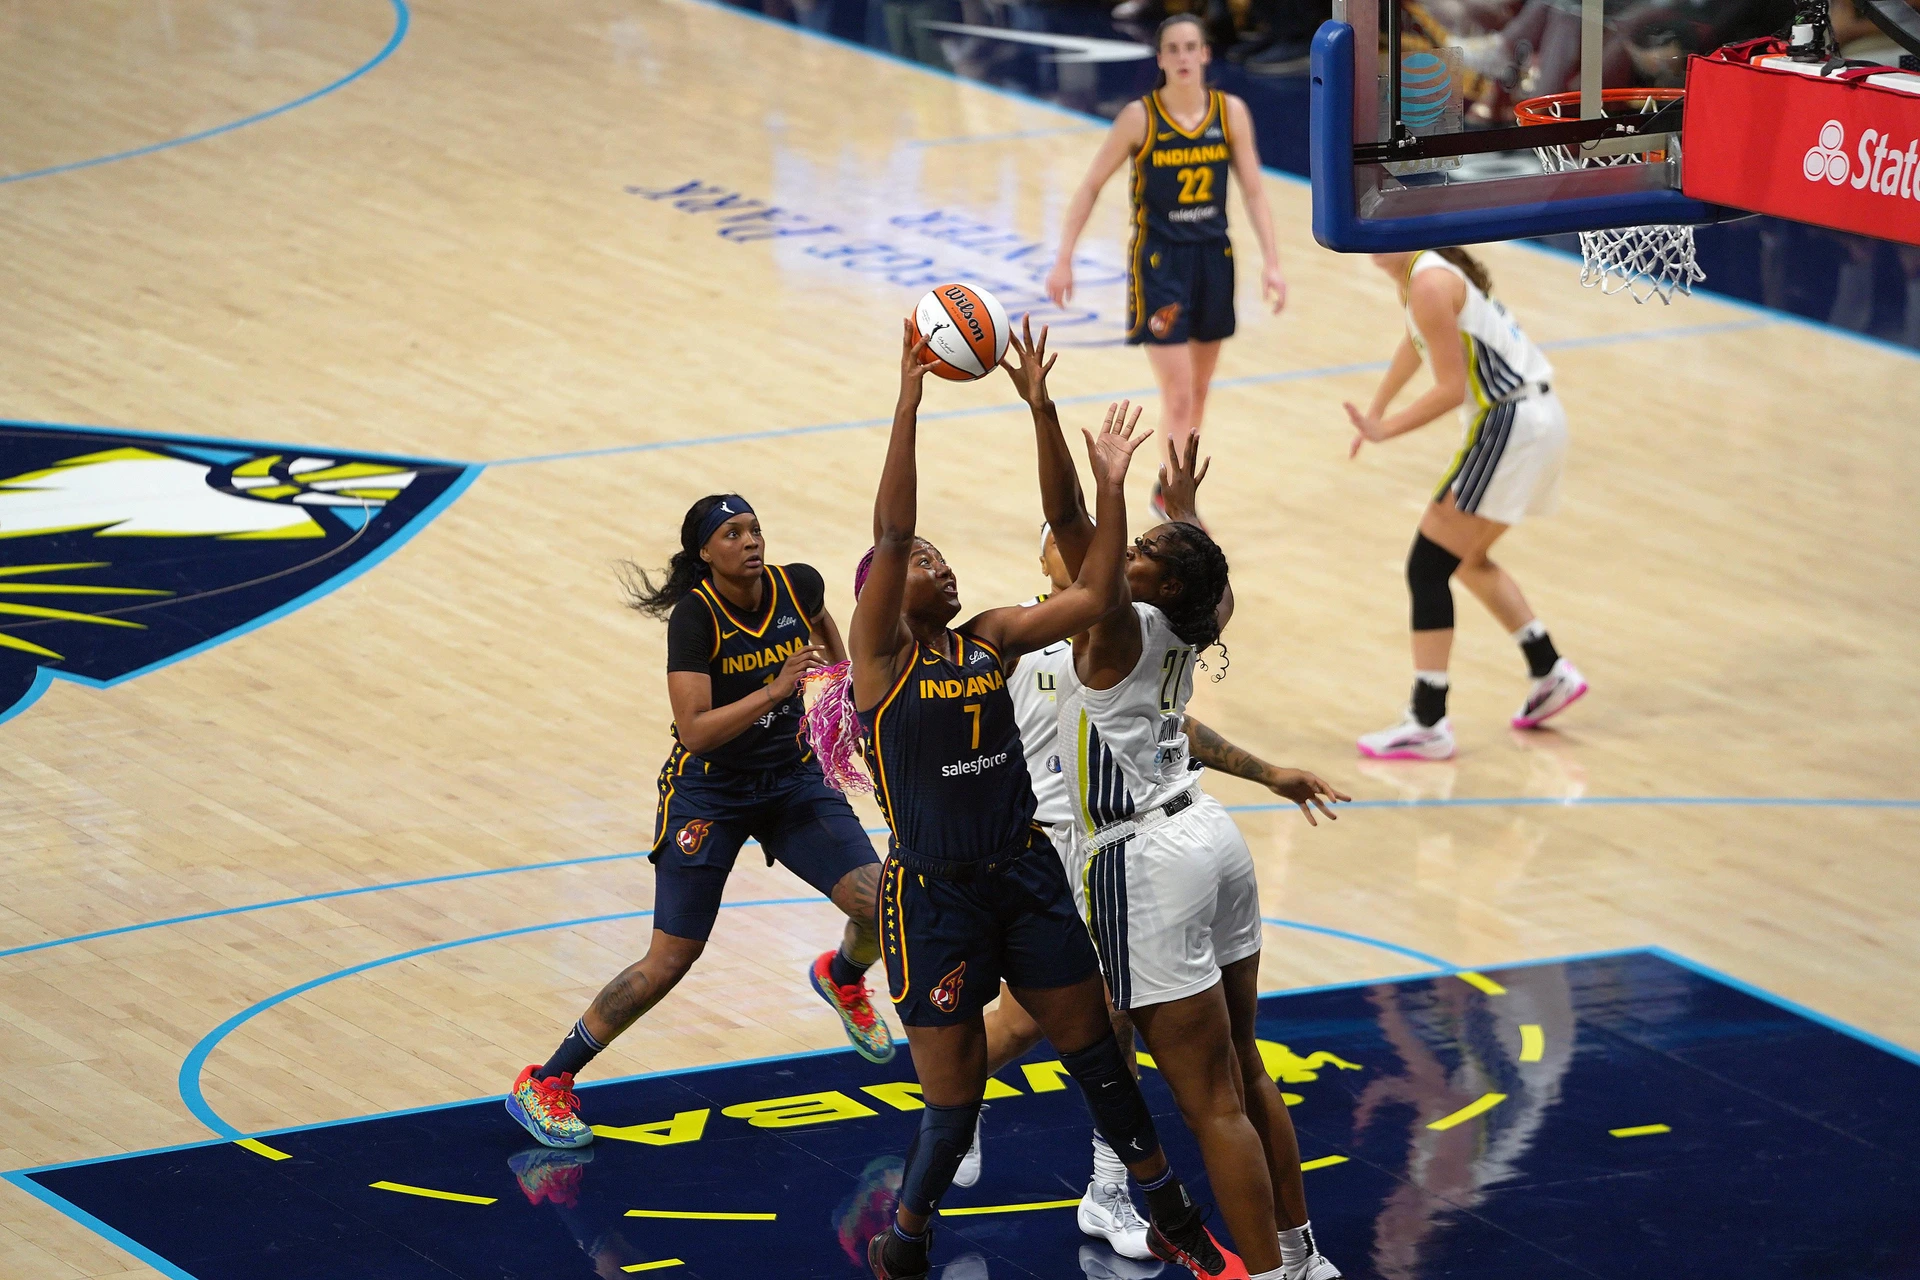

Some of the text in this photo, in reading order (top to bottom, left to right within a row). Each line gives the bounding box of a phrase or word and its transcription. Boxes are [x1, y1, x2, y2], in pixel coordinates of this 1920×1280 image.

[1152, 144, 1231, 167] INDIANA
[1176, 166, 1214, 204] 22
[944, 286, 985, 343] Wilson
[777, 615, 797, 629] Lilly
[722, 636, 805, 675] INDIANA
[920, 669, 1004, 699] INDIANA
[1159, 646, 1192, 714] 21
[963, 703, 981, 750] 7
[941, 752, 1008, 777] salesforce
